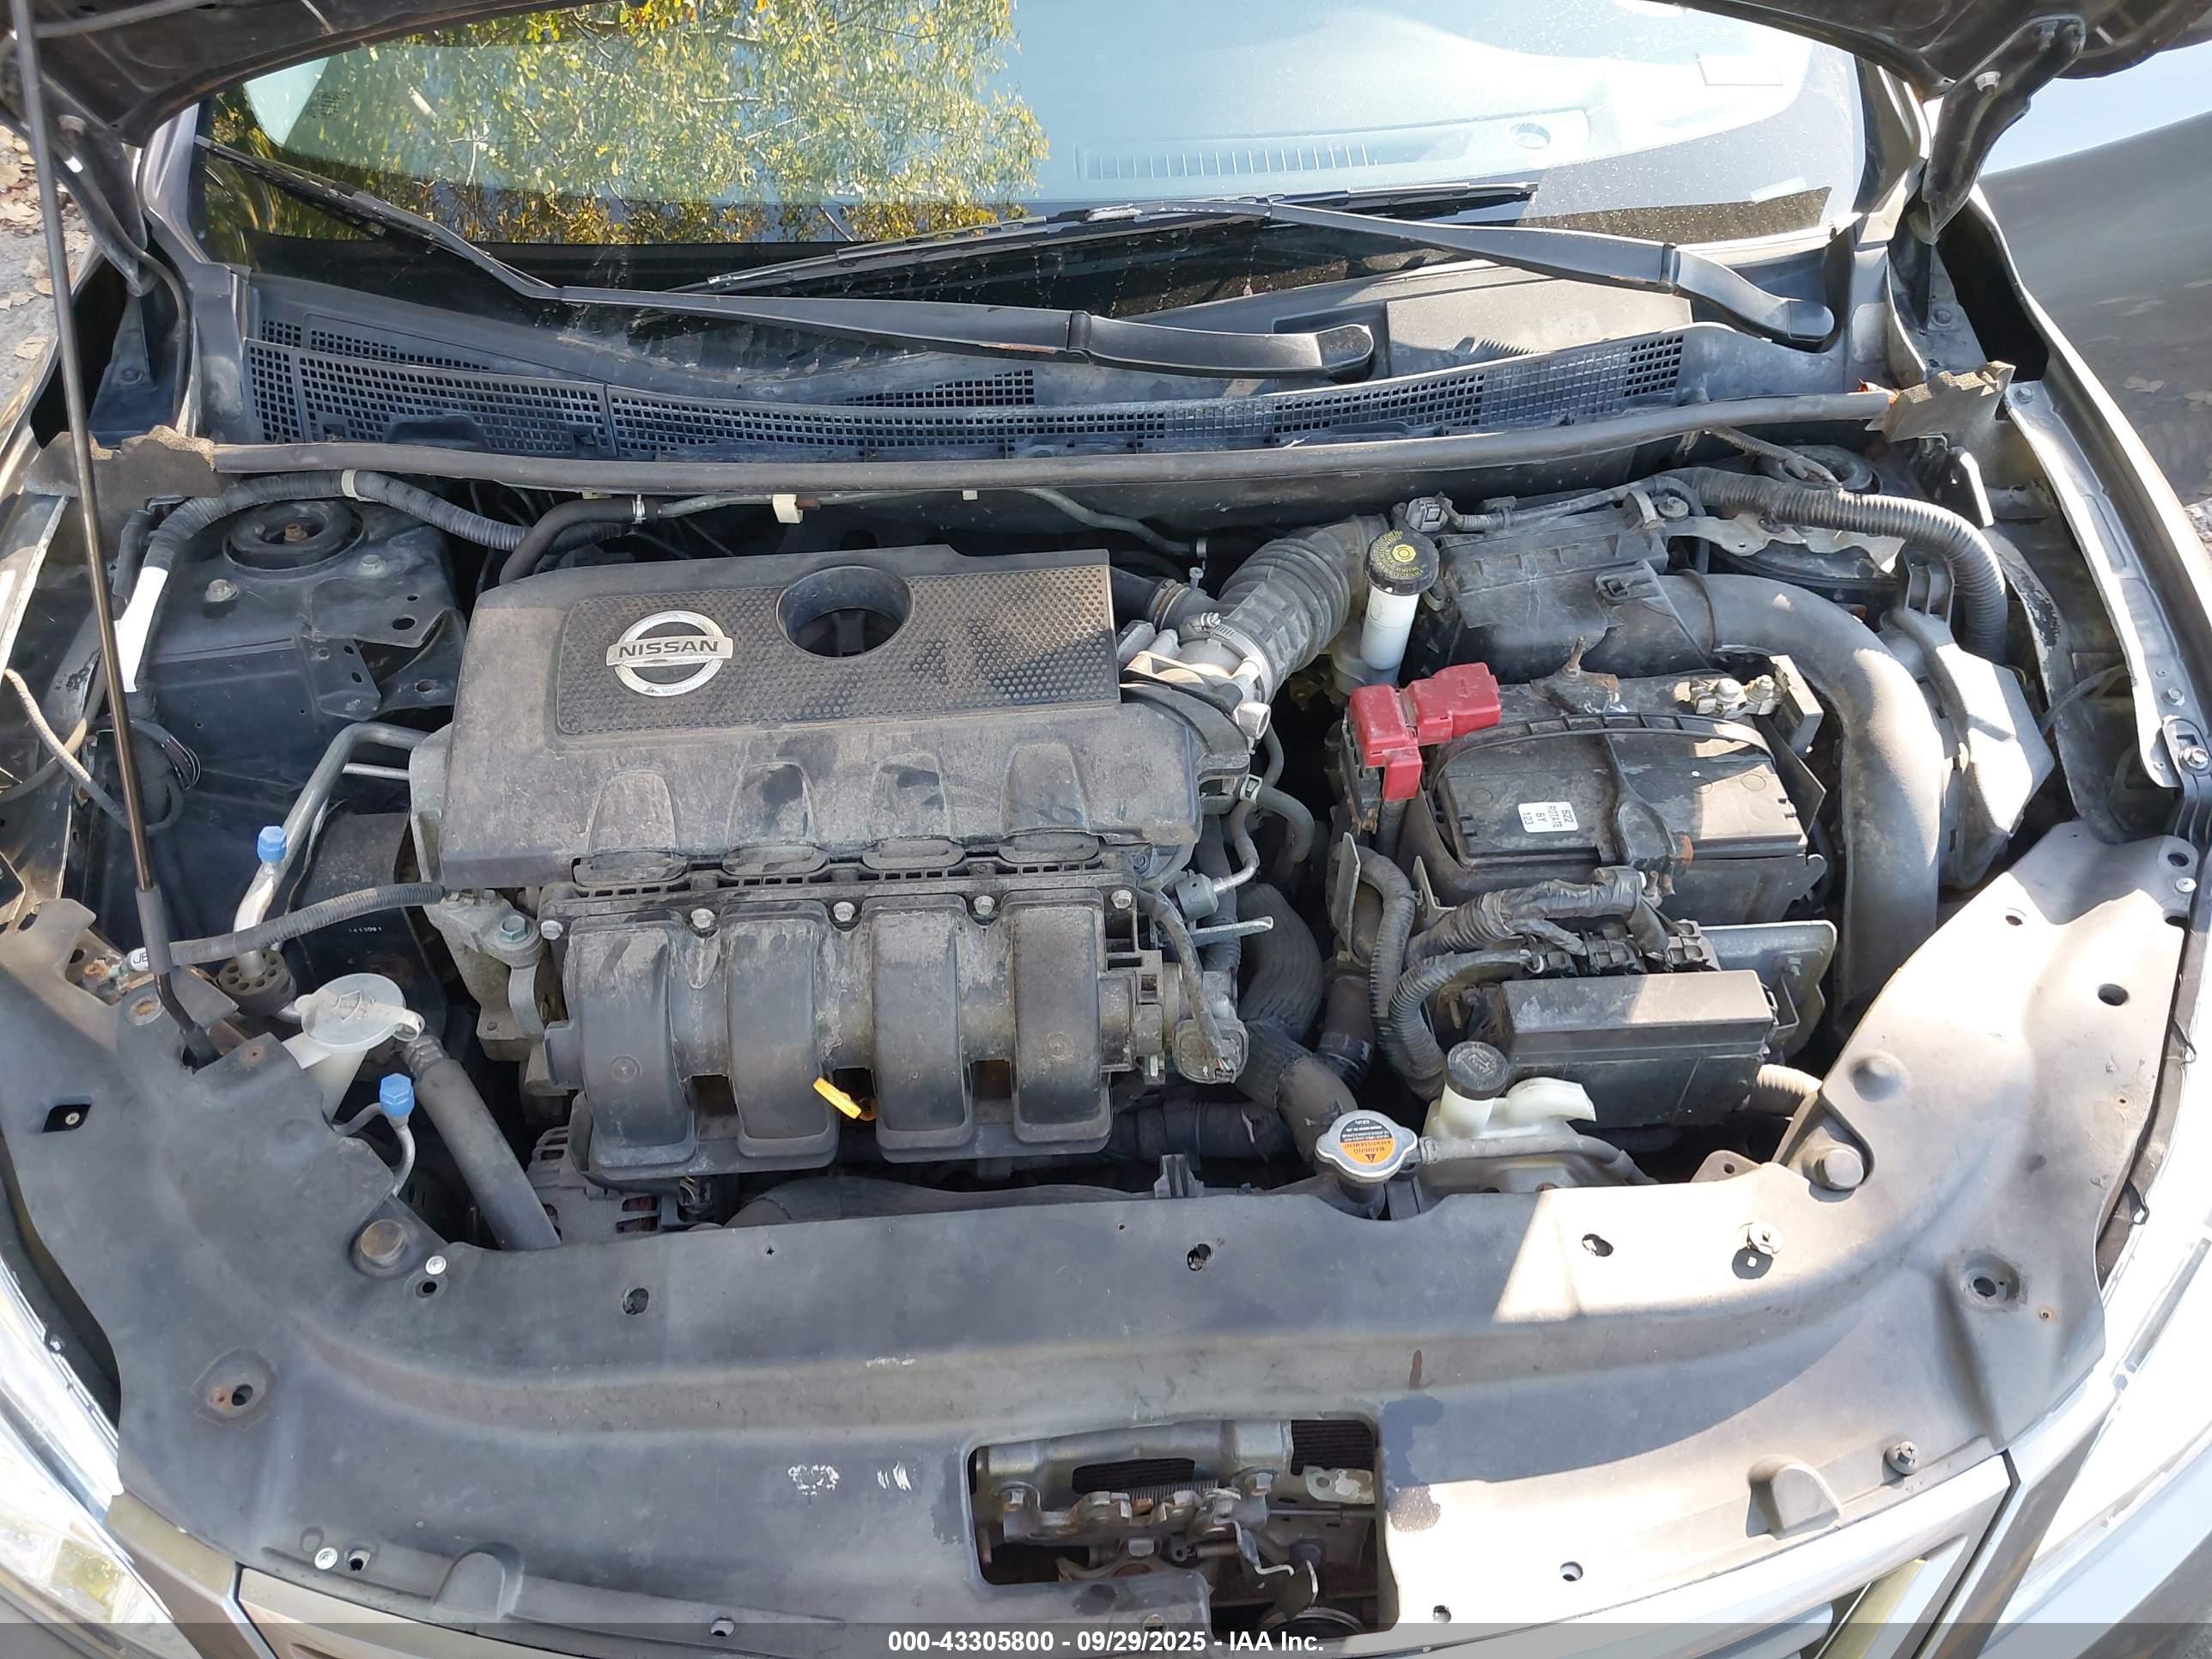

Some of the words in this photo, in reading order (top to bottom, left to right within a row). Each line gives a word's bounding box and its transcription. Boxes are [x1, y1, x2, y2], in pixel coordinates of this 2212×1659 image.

[618, 640, 719, 659] NISSAN
[1522, 812, 1534, 825] 123
[1535, 812, 1547, 823] BY
